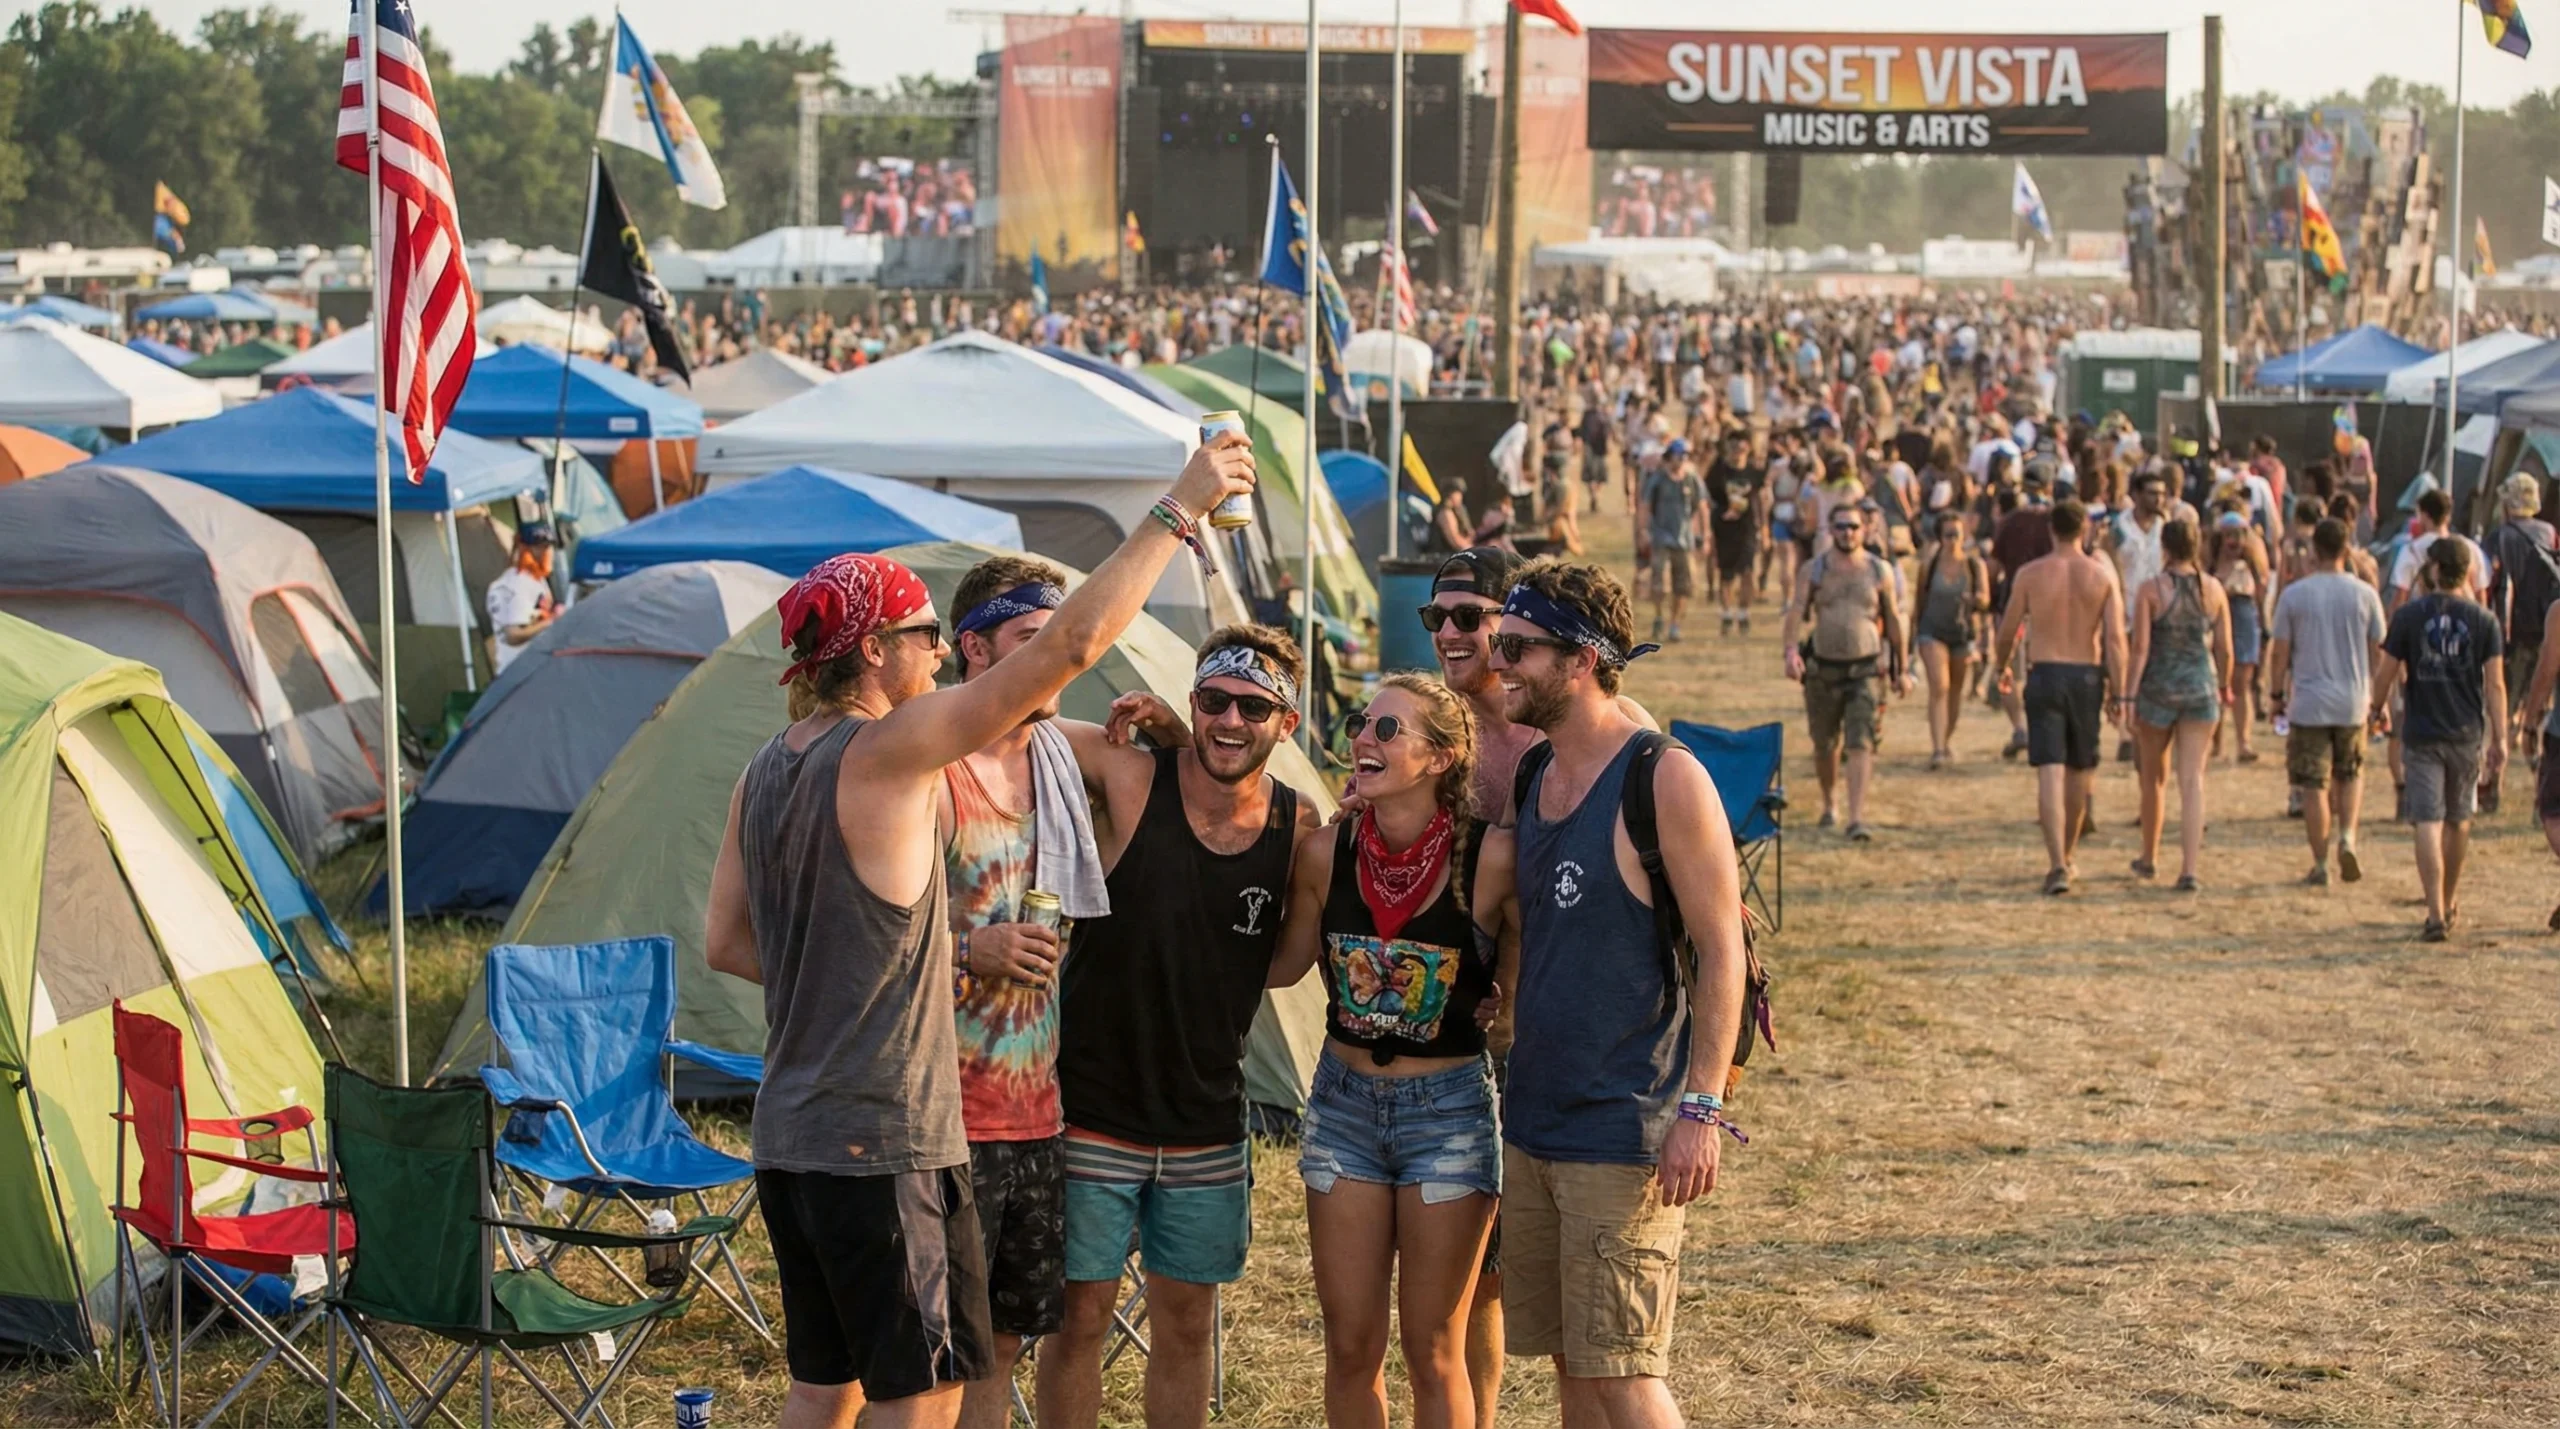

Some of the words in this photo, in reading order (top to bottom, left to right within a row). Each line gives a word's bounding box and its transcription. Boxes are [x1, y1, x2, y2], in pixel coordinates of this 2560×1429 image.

[1666, 43, 1901, 104] SUNSET
[1916, 46, 2088, 107] VISTA
[1764, 113, 1867, 145] MUSIC
[1875, 115, 1898, 147] &
[1905, 115, 1990, 147] ARTS
